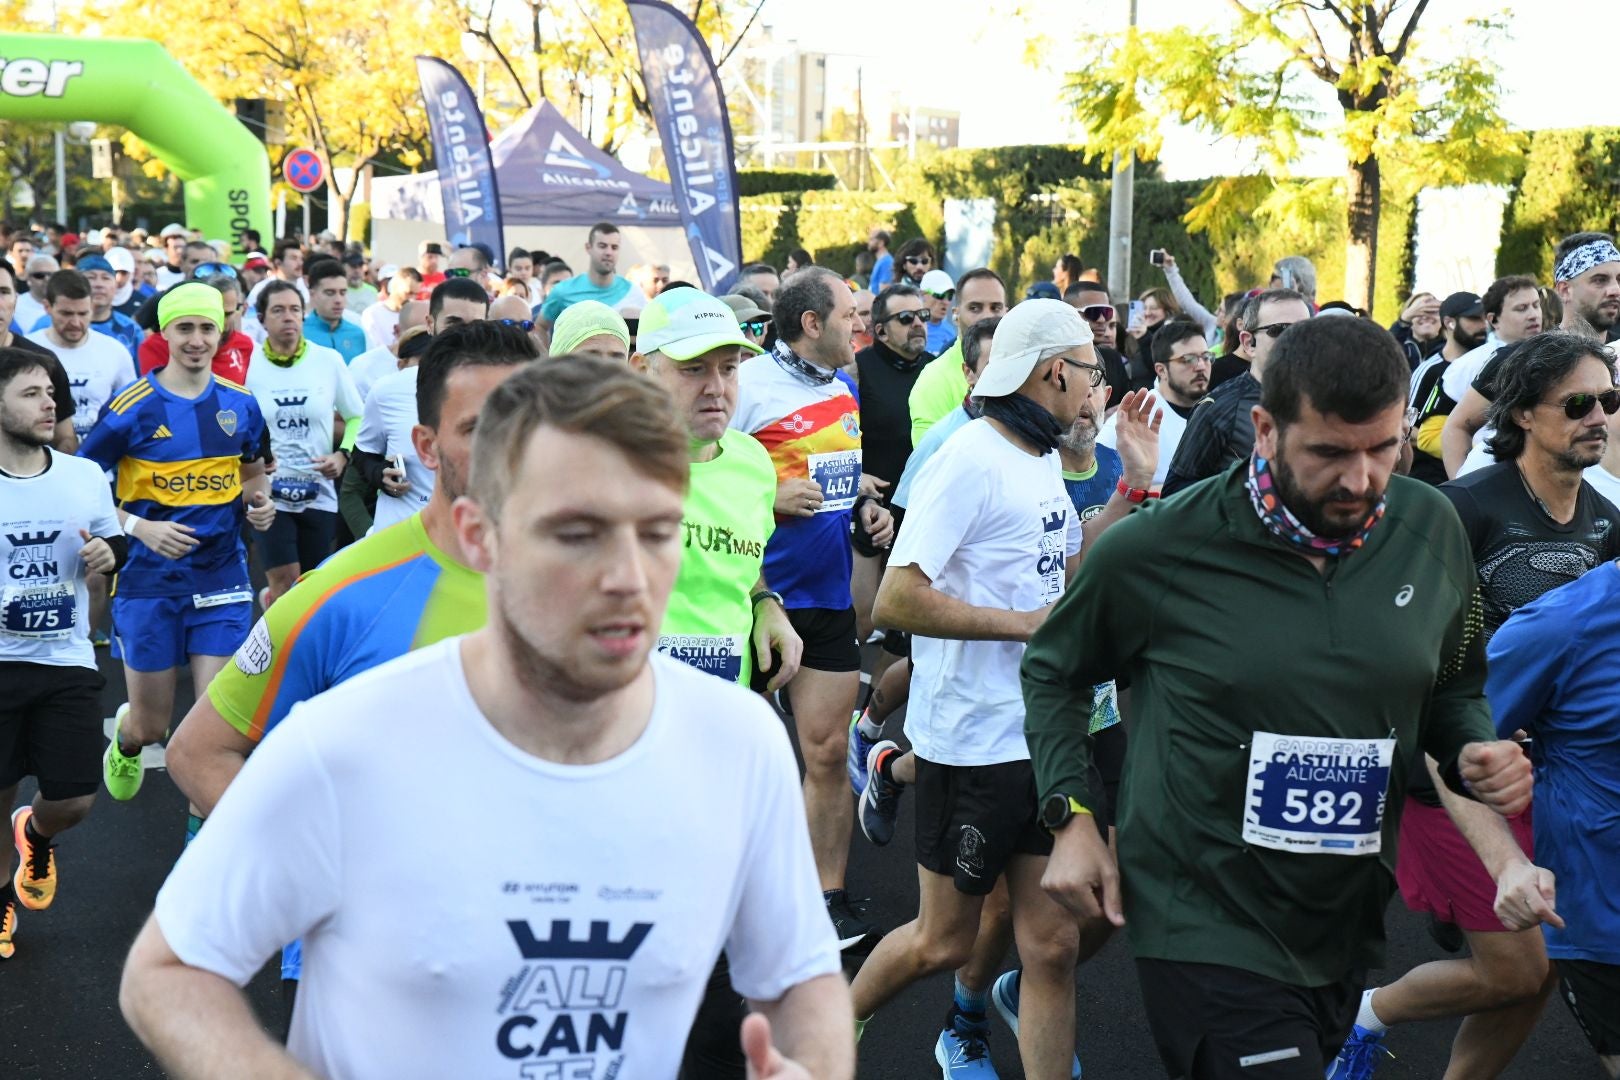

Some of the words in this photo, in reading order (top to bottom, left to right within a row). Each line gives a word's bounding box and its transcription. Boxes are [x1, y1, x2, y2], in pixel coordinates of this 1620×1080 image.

[0, 56, 84, 98] er
[543, 173, 631, 189] Alicante
[694, 312, 725, 320] KIPRUN
[277, 417, 309, 429] CAN
[826, 476, 854, 496] 447
[9, 561, 58, 579] CAN
[1037, 551, 1065, 575] CAN
[13, 589, 69, 602] CASTILLOS
[20, 597, 63, 609] ALICANTE
[22, 609, 59, 628] 175
[678, 657, 727, 668] ICANTE
[1274, 738, 1367, 756] CARRERA
[1271, 751, 1380, 768] CASTILLOS
[1285, 766, 1367, 783] ALICANTE
[1281, 788, 1363, 826] 582
[512, 964, 627, 1011] ALI
[496, 1011, 629, 1060] CAN
